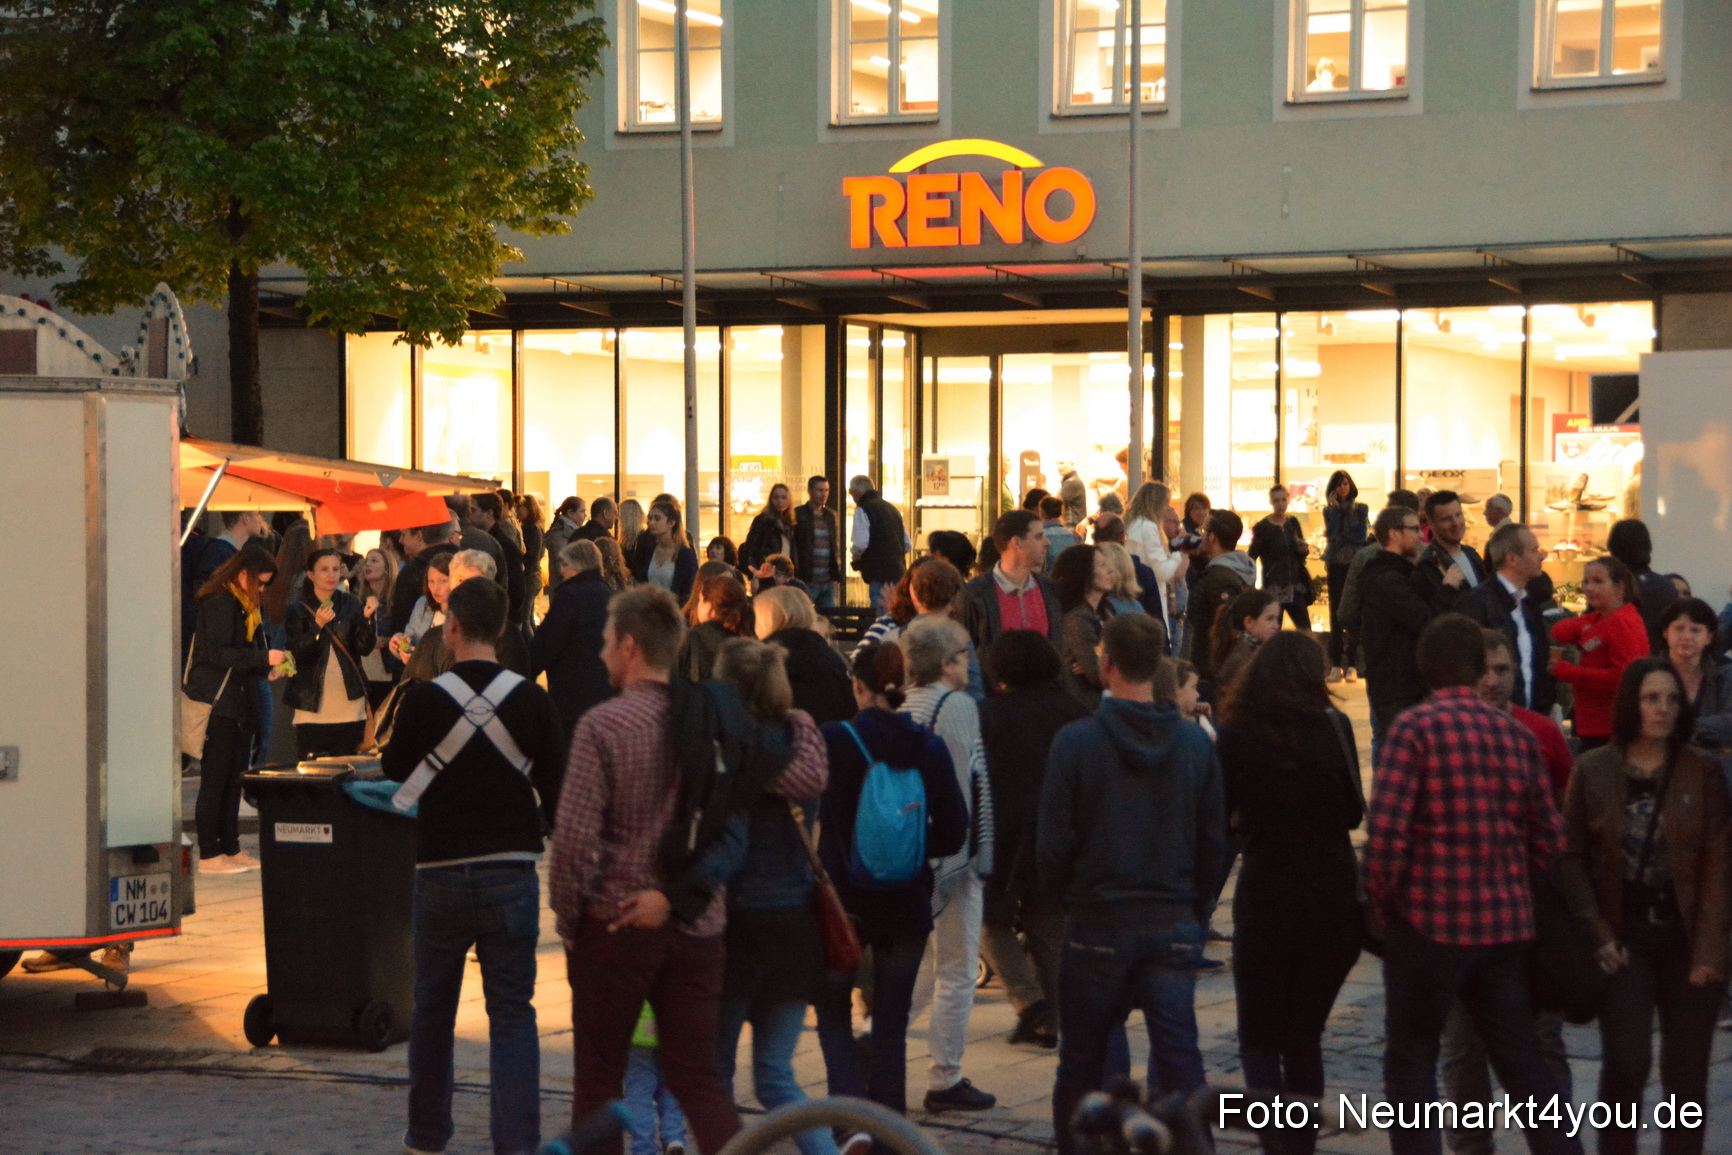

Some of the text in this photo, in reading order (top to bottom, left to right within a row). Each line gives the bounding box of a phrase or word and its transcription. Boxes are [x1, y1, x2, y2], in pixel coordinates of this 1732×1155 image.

[842, 166, 1096, 249] RENO
[1419, 470, 1466, 479] GEOX
[276, 825, 321, 835] NEUMARKT
[126, 878, 147, 901] NM
[115, 899, 168, 926] CW 104
